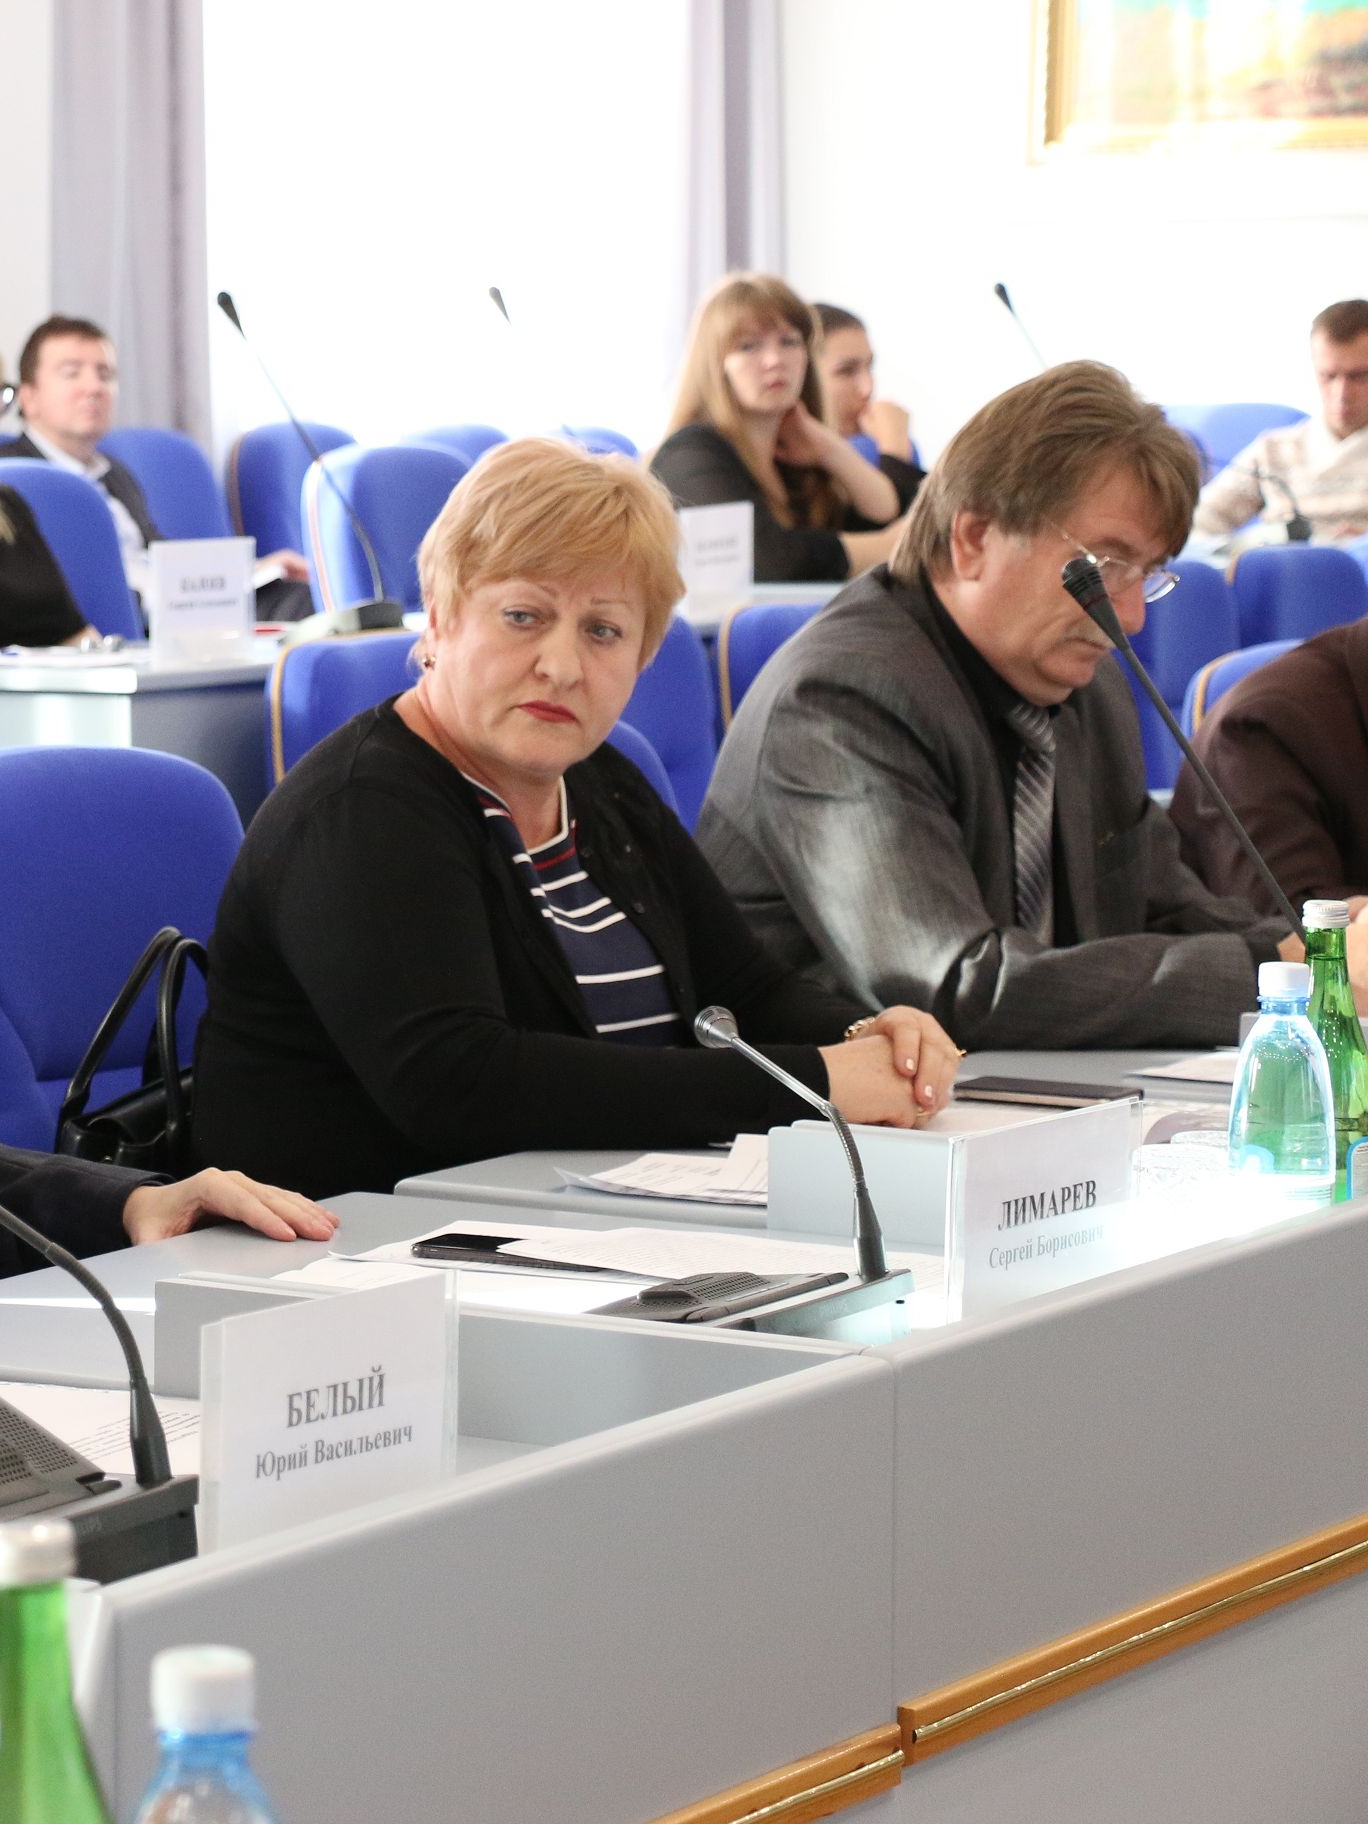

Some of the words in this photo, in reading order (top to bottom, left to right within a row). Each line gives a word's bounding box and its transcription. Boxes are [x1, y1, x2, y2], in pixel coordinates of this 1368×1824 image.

[997, 1179, 1098, 1232] ЛИМАРЕВ
[988, 1238, 1033, 1271] Сергей
[287, 1364, 386, 1428] БЕЛЫЙ
[255, 1443, 308, 1481] Юрий
[314, 1425, 413, 1465] Васильевич
